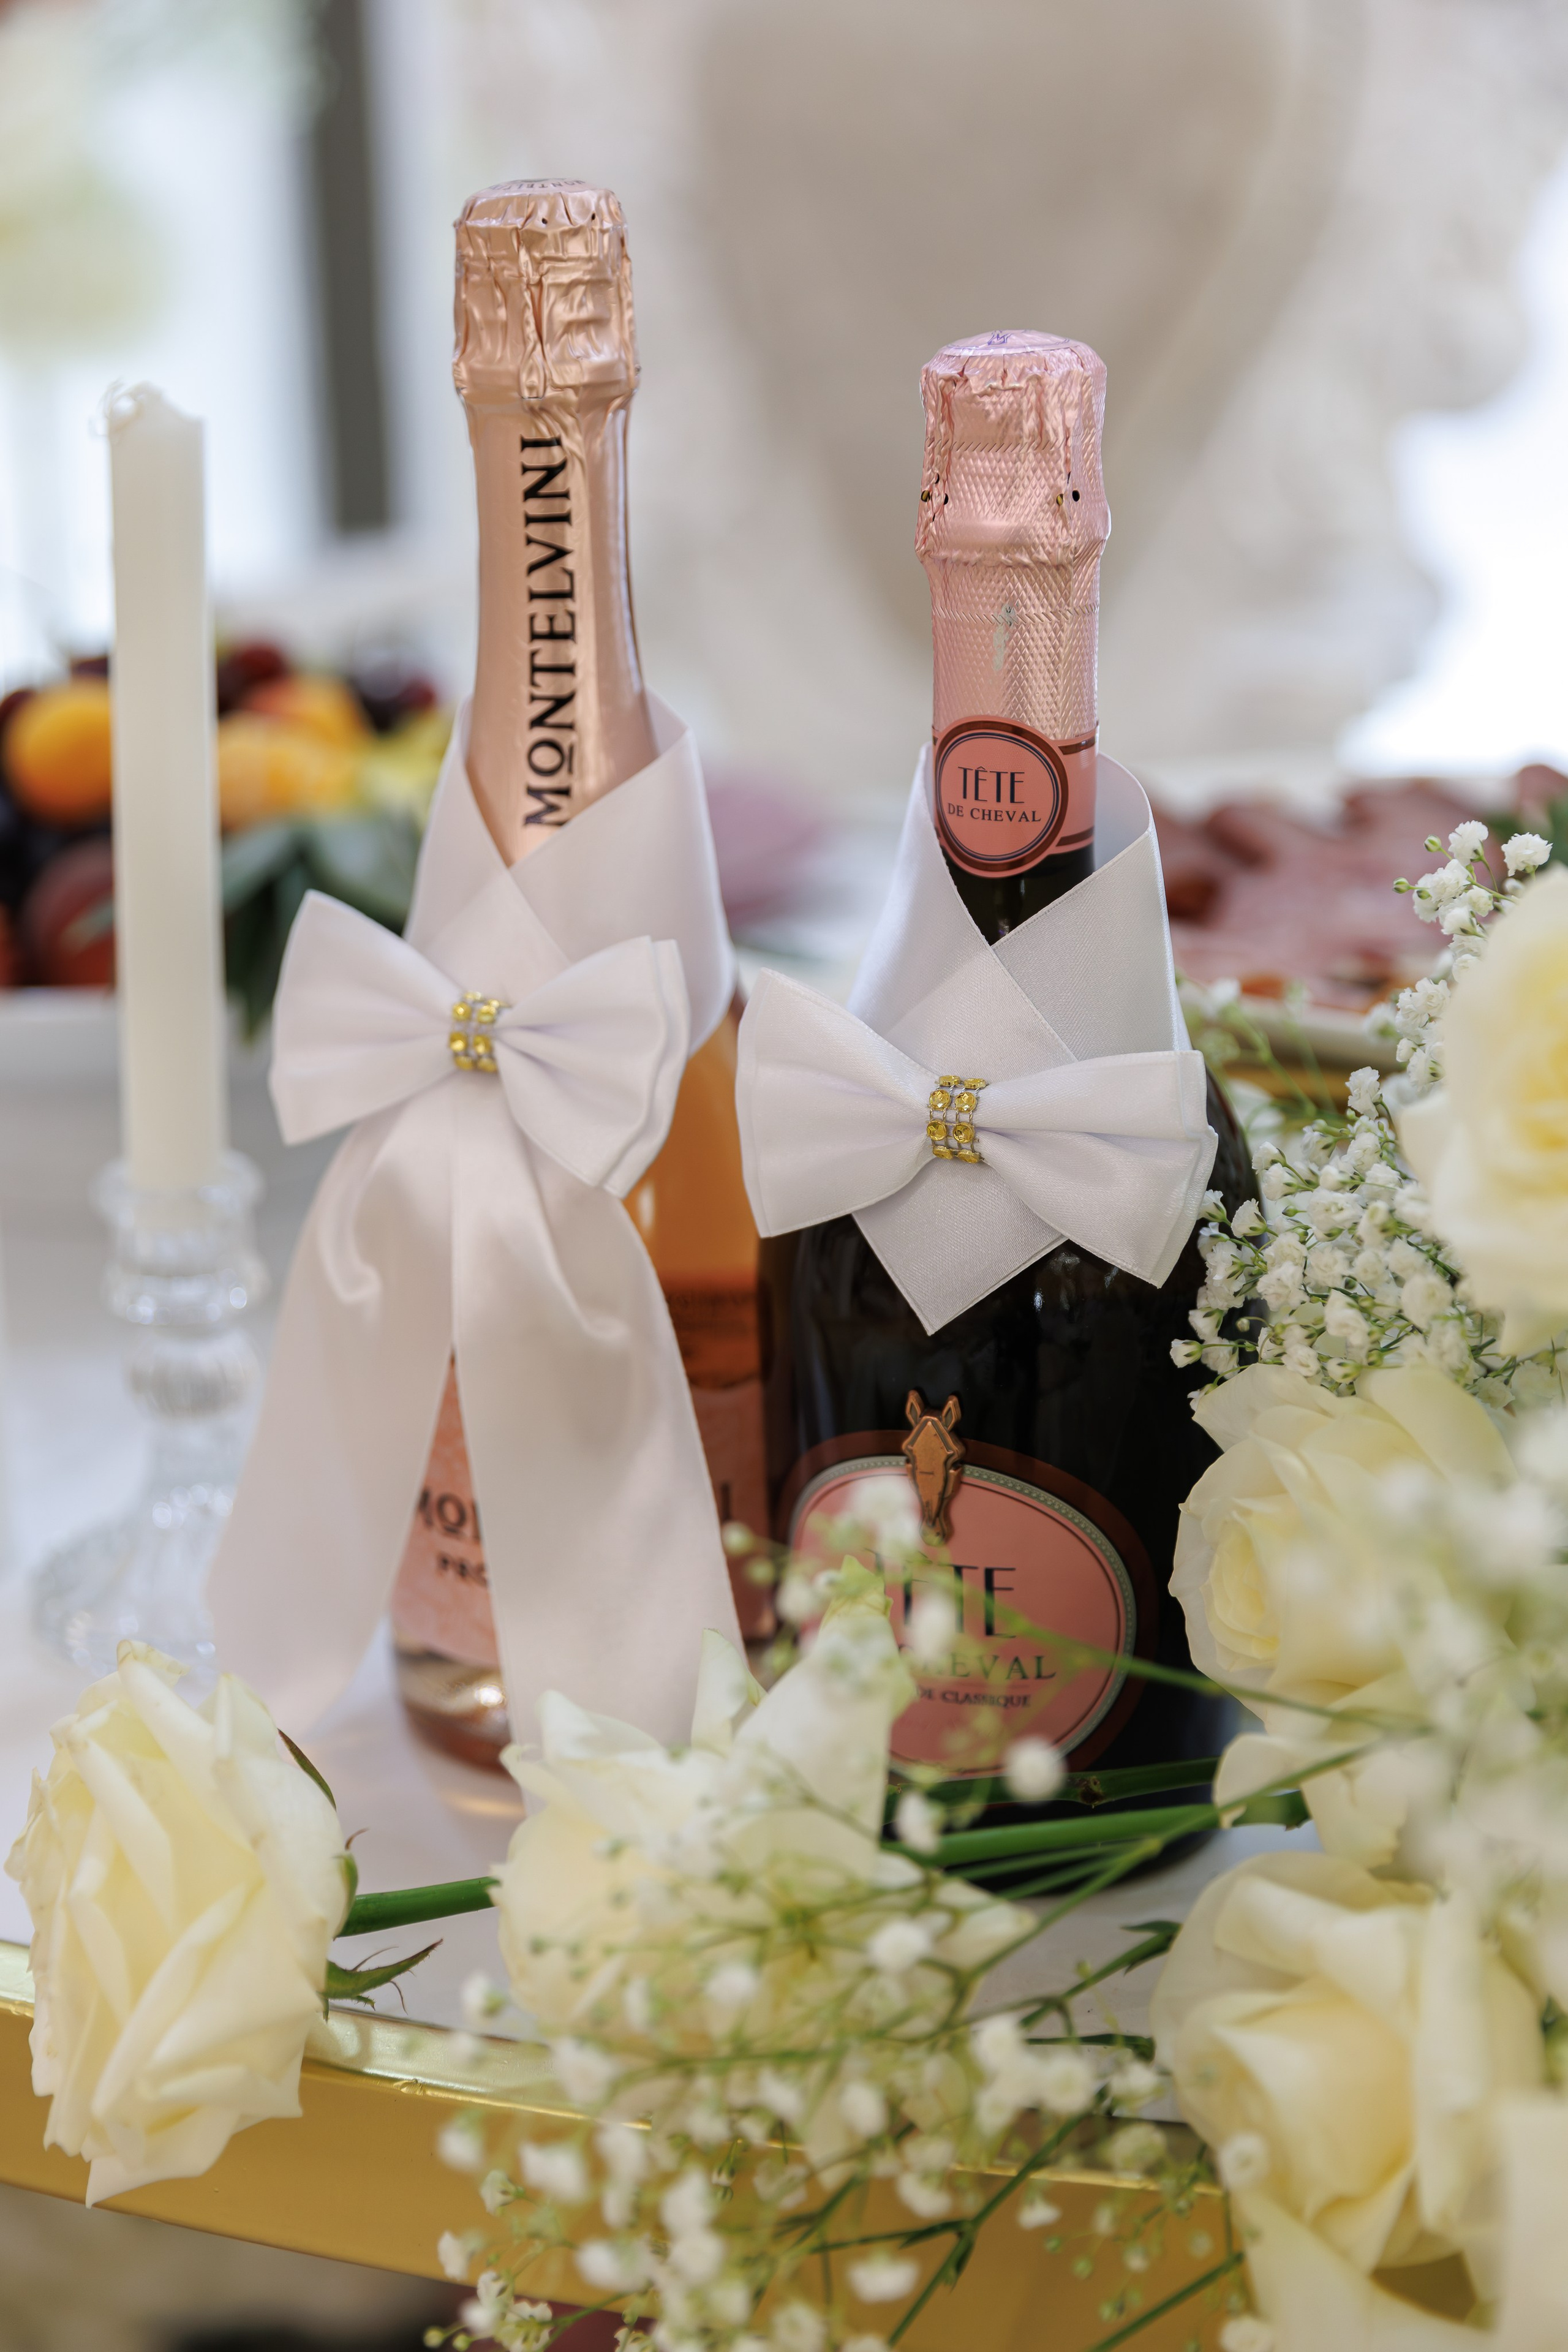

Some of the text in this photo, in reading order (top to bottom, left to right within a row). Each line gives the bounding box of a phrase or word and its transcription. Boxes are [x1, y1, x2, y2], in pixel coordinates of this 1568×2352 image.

[519, 433, 577, 827] MONTELVINI
[957, 766, 1025, 804] TÊTE
[947, 802, 1042, 823] DE CHEVAL
[899, 1643, 1058, 1679] EVAL
